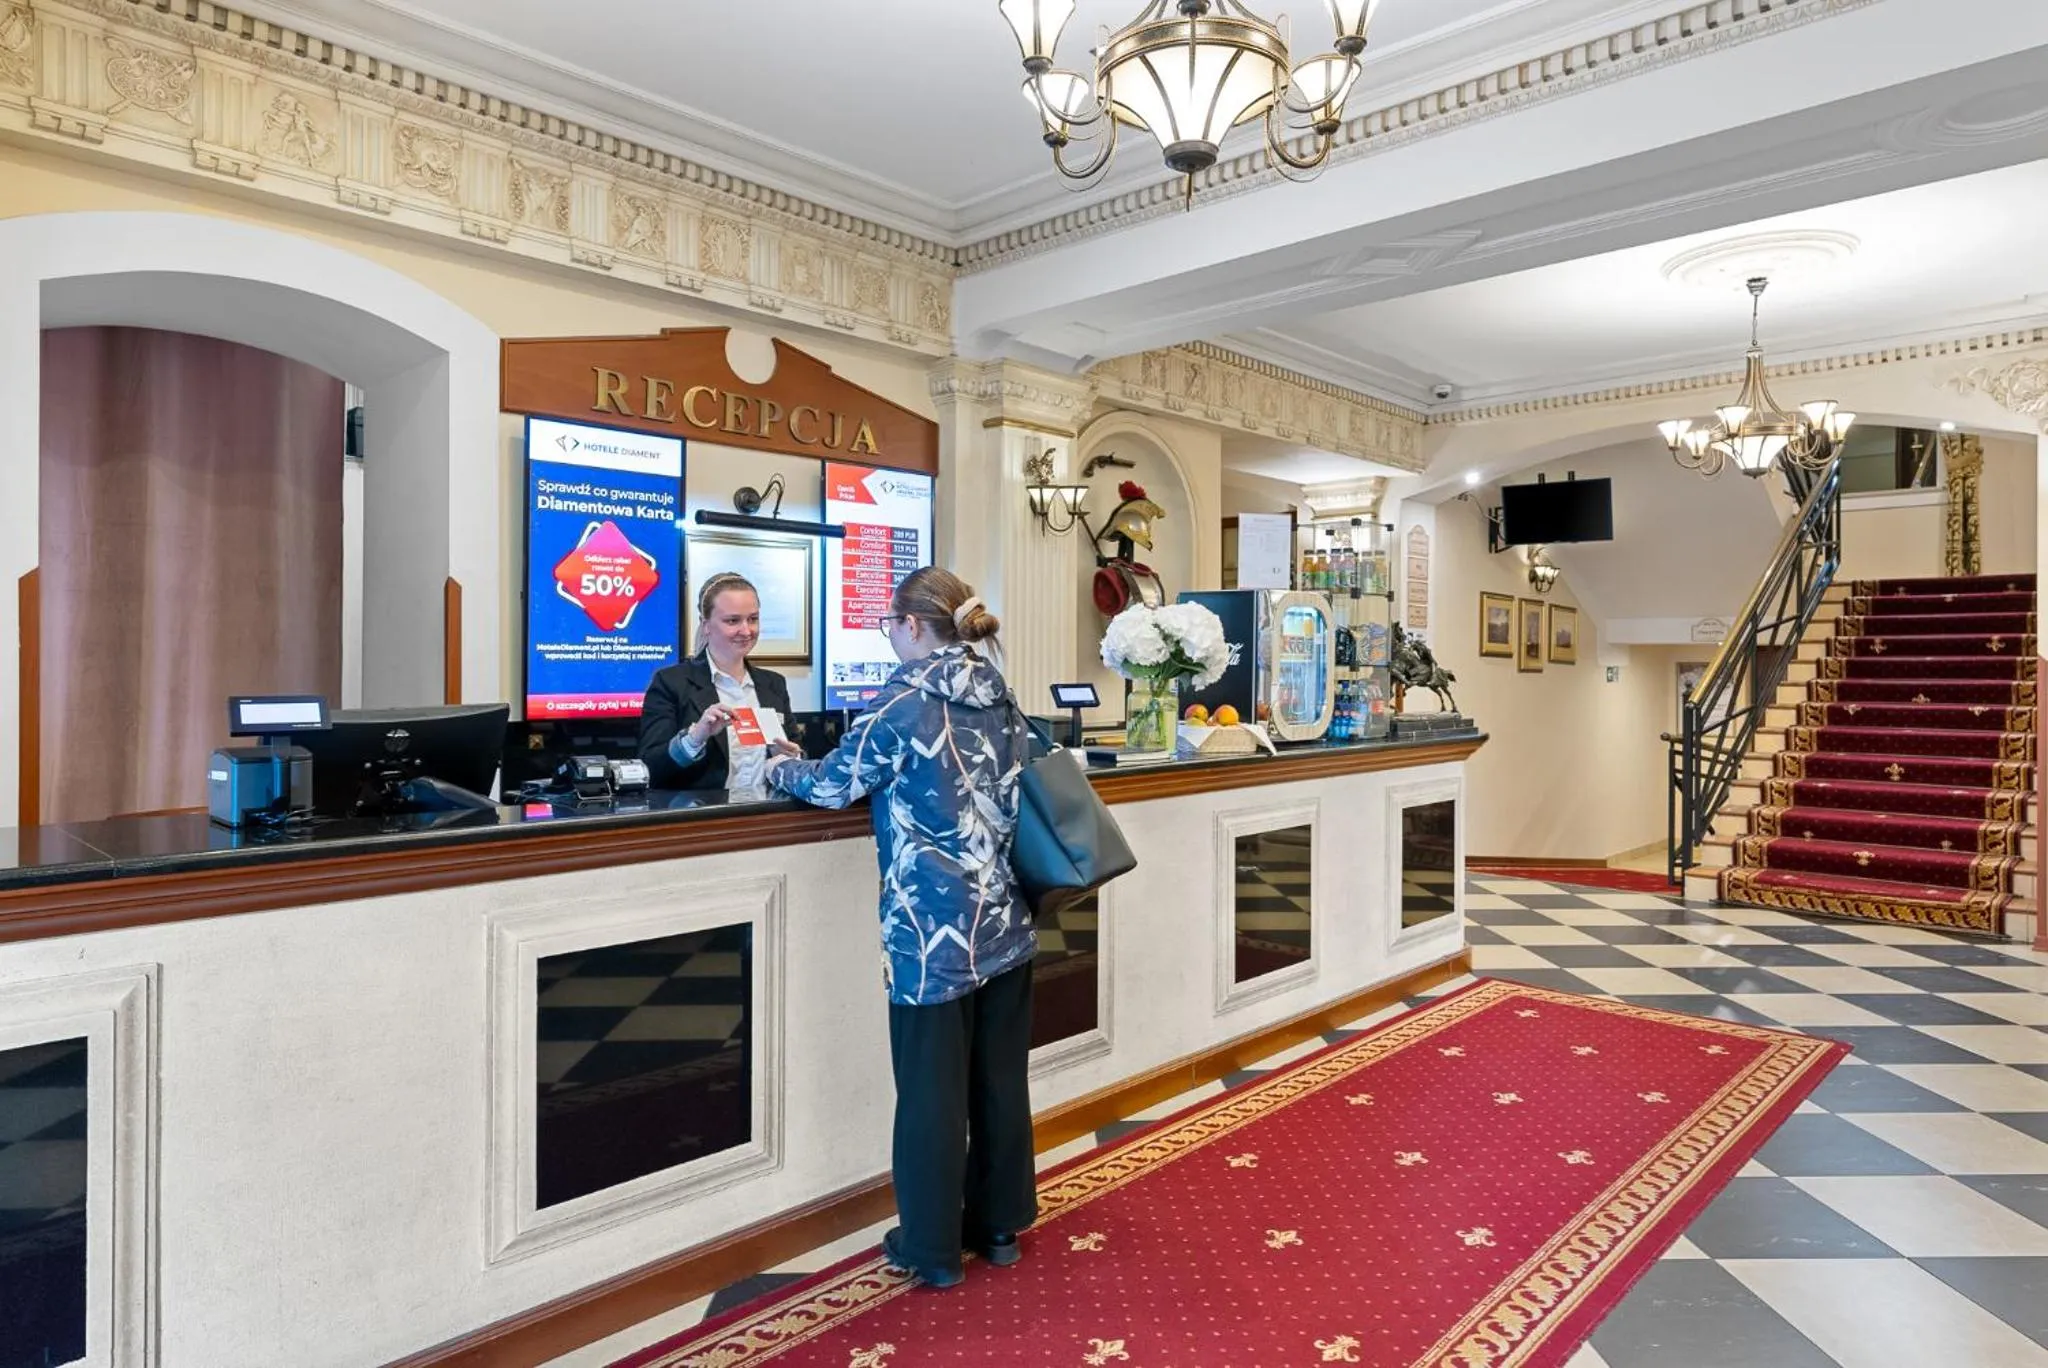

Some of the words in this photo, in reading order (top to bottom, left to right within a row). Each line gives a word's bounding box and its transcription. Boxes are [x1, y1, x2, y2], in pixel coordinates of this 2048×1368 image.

[592, 366, 880, 455] RECEPCJA
[583, 442, 619, 455] HOTELE
[621, 447, 661, 460] DIAMENT
[538, 479, 591, 496] Sprawdź
[593, 487, 608, 497] co
[609, 489, 674, 506] gwarantuje
[537, 495, 633, 517] Diamentowa
[636, 505, 674, 521] Karta
[860, 526, 886, 536] Comfort
[860, 540, 886, 549] Comfort
[860, 555, 886, 564] Comfort
[580, 573, 636, 598] 50%
[546, 702, 555, 711] O
[556, 701, 597, 711] szczegóły
[598, 700, 619, 711] pytaj
